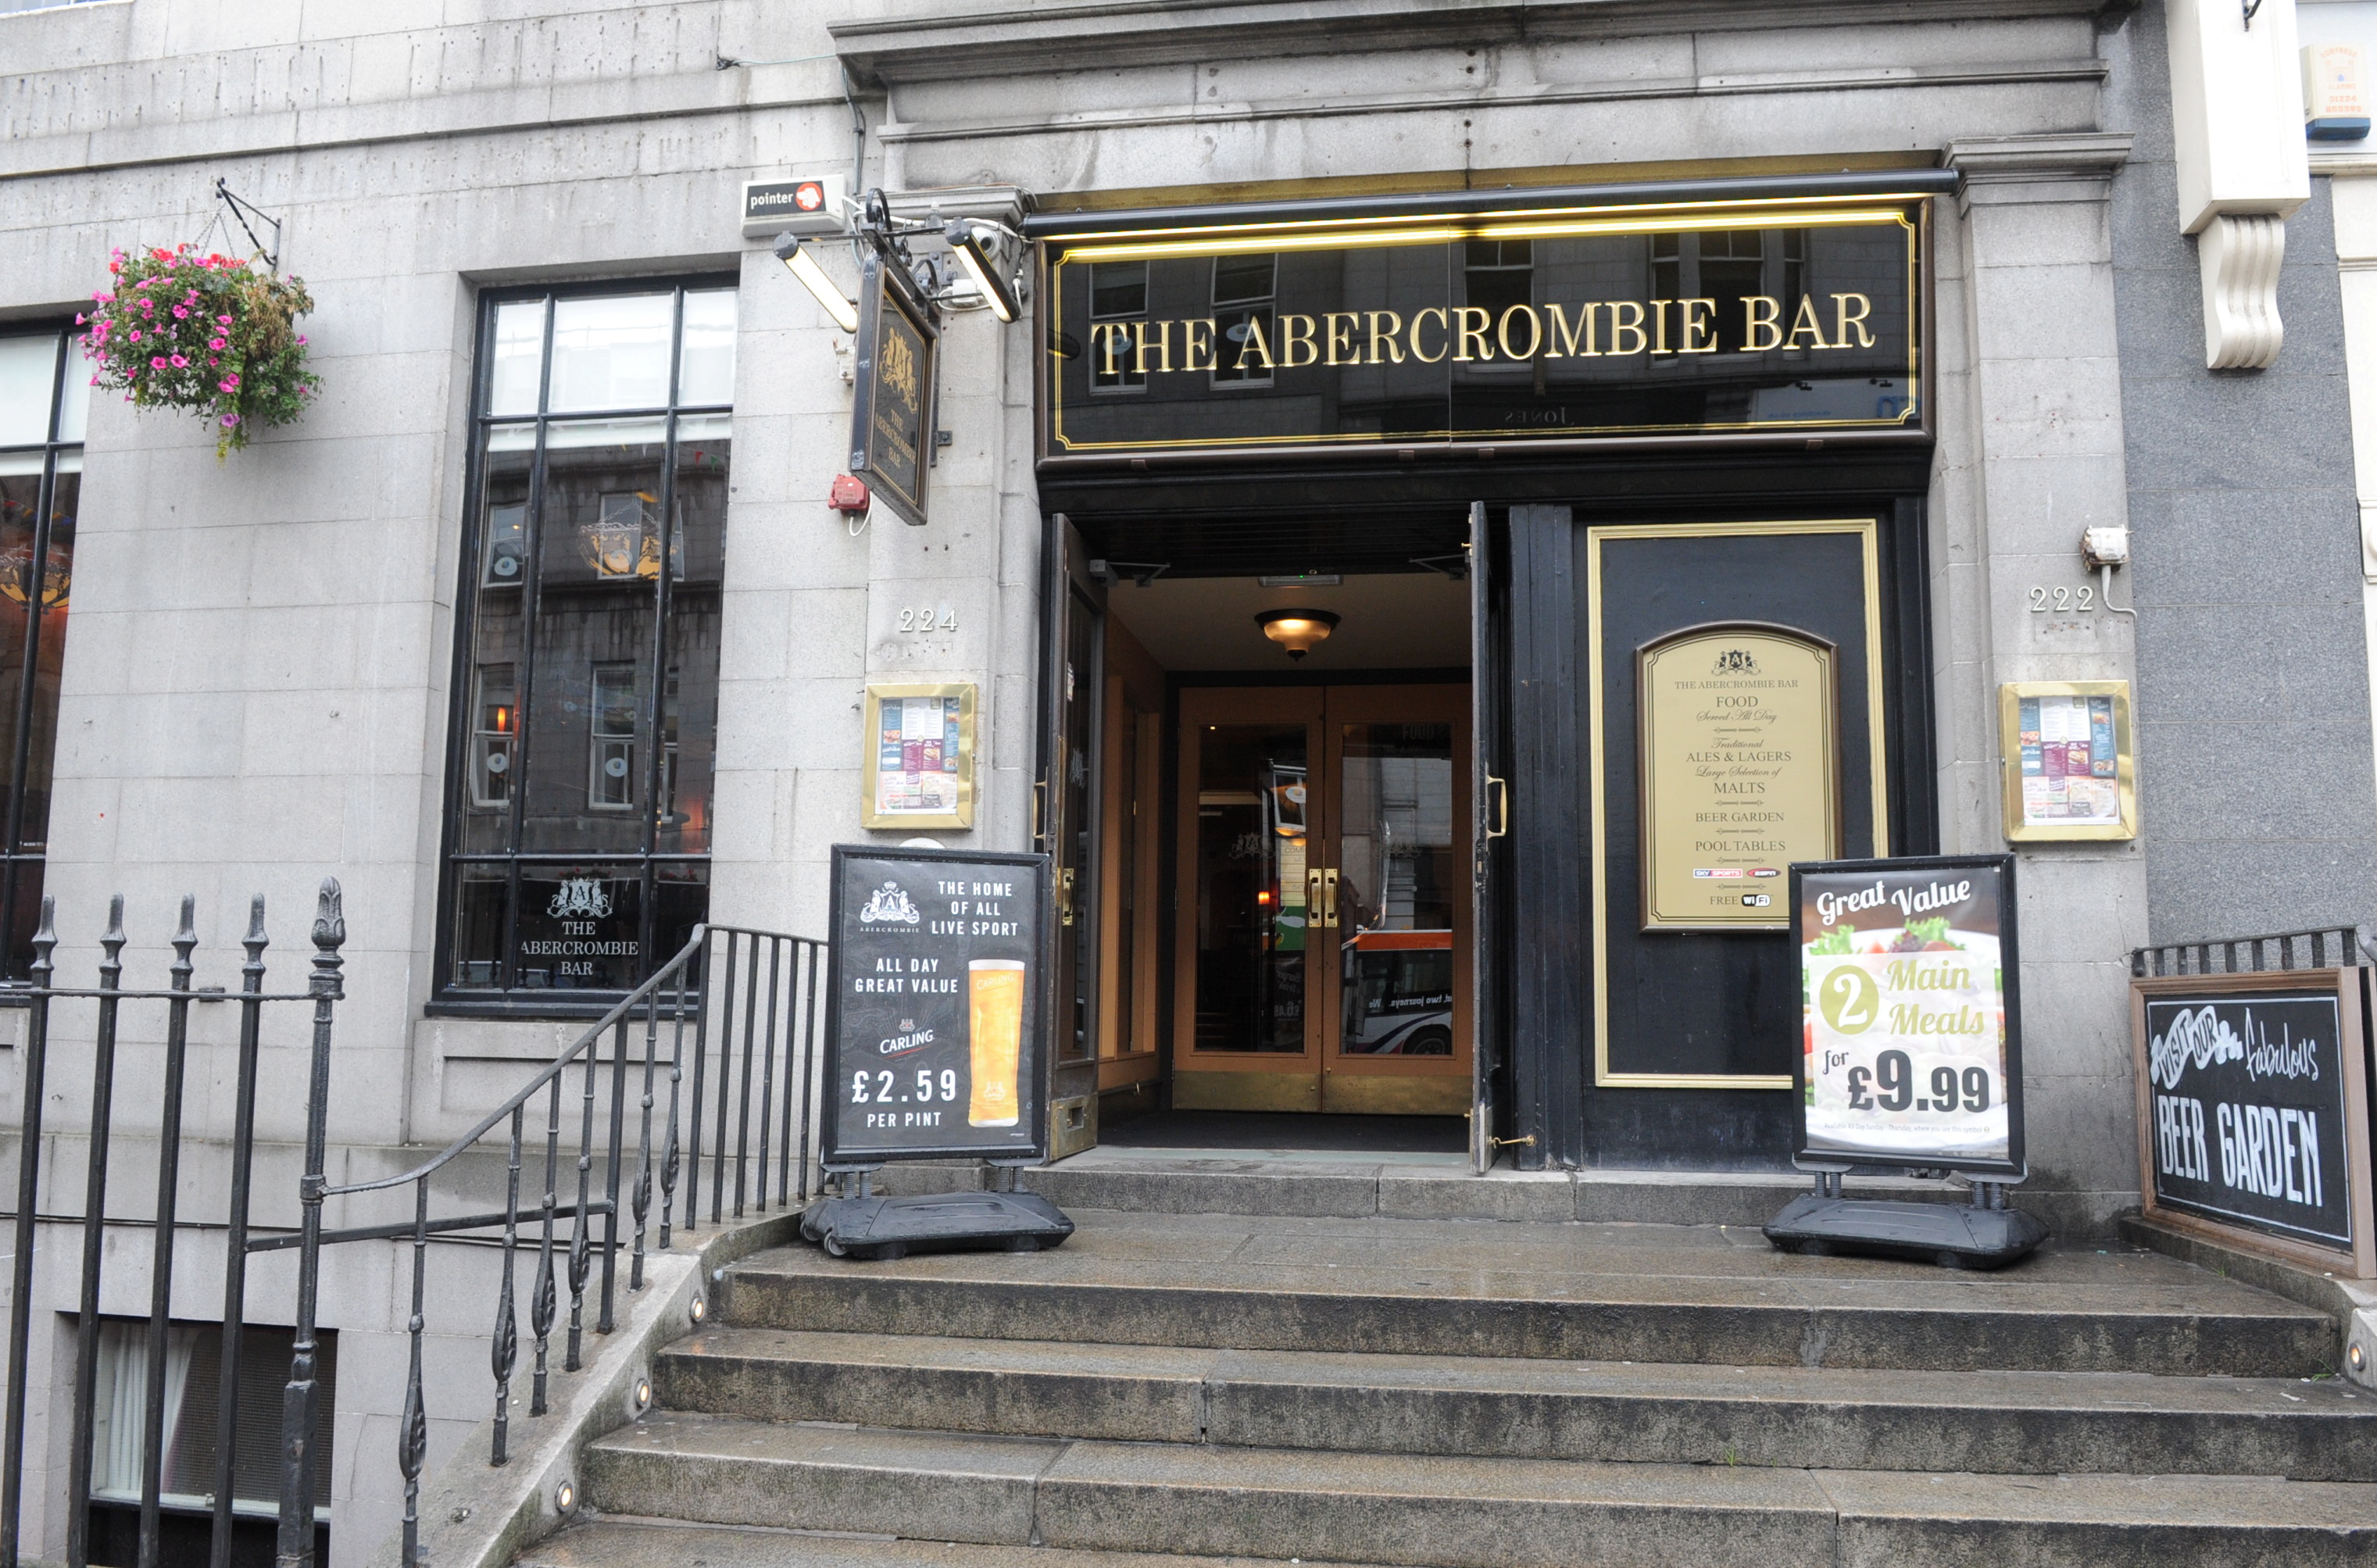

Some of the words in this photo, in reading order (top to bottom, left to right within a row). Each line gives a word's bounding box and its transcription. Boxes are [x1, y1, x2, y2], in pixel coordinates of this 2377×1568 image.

[750, 192, 793, 209] pointer
[1091, 320, 1218, 375] THE
[1232, 299, 1718, 370] ABERCROMBIE
[1739, 292, 1875, 352] BAR
[891, 409, 903, 432] THE
[874, 413, 917, 465] ABERCROMBIE
[888, 446, 901, 469] BAR
[2030, 586, 2093, 613] 222
[899, 609, 958, 632] 224
[1698, 680, 1775, 689] ABERCROMBIE
[1778, 680, 1799, 688] BAR
[1716, 696, 1758, 708] FOOD
[1696, 710, 1731, 722] Served
[1731, 709, 1753, 721] All
[1753, 709, 1777, 724] Day
[1710, 738, 1765, 748] Traditional
[1686, 752, 1720, 763] ALES
[1724, 752, 1734, 763] &
[1739, 751, 1792, 762] LAGERS
[1695, 765, 1726, 780] Large
[1728, 765, 1769, 777] Selection
[1771, 766, 1782, 779] of
[1714, 782, 1765, 794] MALTS
[1695, 813, 1728, 823] BEER
[1731, 812, 1784, 822] GARDEN
[1695, 841, 1732, 852] POOL
[1733, 841, 1785, 851] TABLES
[938, 881, 965, 895] THE
[973, 882, 1012, 897] HOME
[951, 901, 969, 915] OF
[976, 902, 1001, 916] ALL
[1710, 896, 1738, 905] FREE
[1816, 880, 1886, 927] Great
[1891, 880, 1971, 916] Value
[562, 921, 595, 934] THE
[931, 920, 965, 934] LIVE
[972, 922, 1018, 936] SPORT
[521, 941, 638, 955] ABERCROMBIE
[560, 962, 593, 975] BAR
[876, 958, 903, 972] ALL
[910, 958, 938, 973] DAY
[976, 973, 1015, 990] CARLING
[1887, 959, 1971, 991] Main
[855, 978, 904, 993] GREAT
[912, 979, 958, 993] VALUE
[1833, 973, 1868, 1028] 2
[1889, 1004, 1986, 1035] Meals
[880, 1030, 935, 1054] CARLING
[2158, 1016, 2192, 1083] VISIT
[2193, 1013, 2218, 1061] OUR
[1823, 1050, 1850, 1075] for
[852, 1069, 956, 1103] £2.59
[1847, 1049, 1989, 1113] £9.99
[867, 1113, 896, 1127] PER
[905, 1112, 942, 1127] PINT
[2157, 1095, 2209, 1183] BEER
[2217, 1102, 2322, 1207] GARDEN
